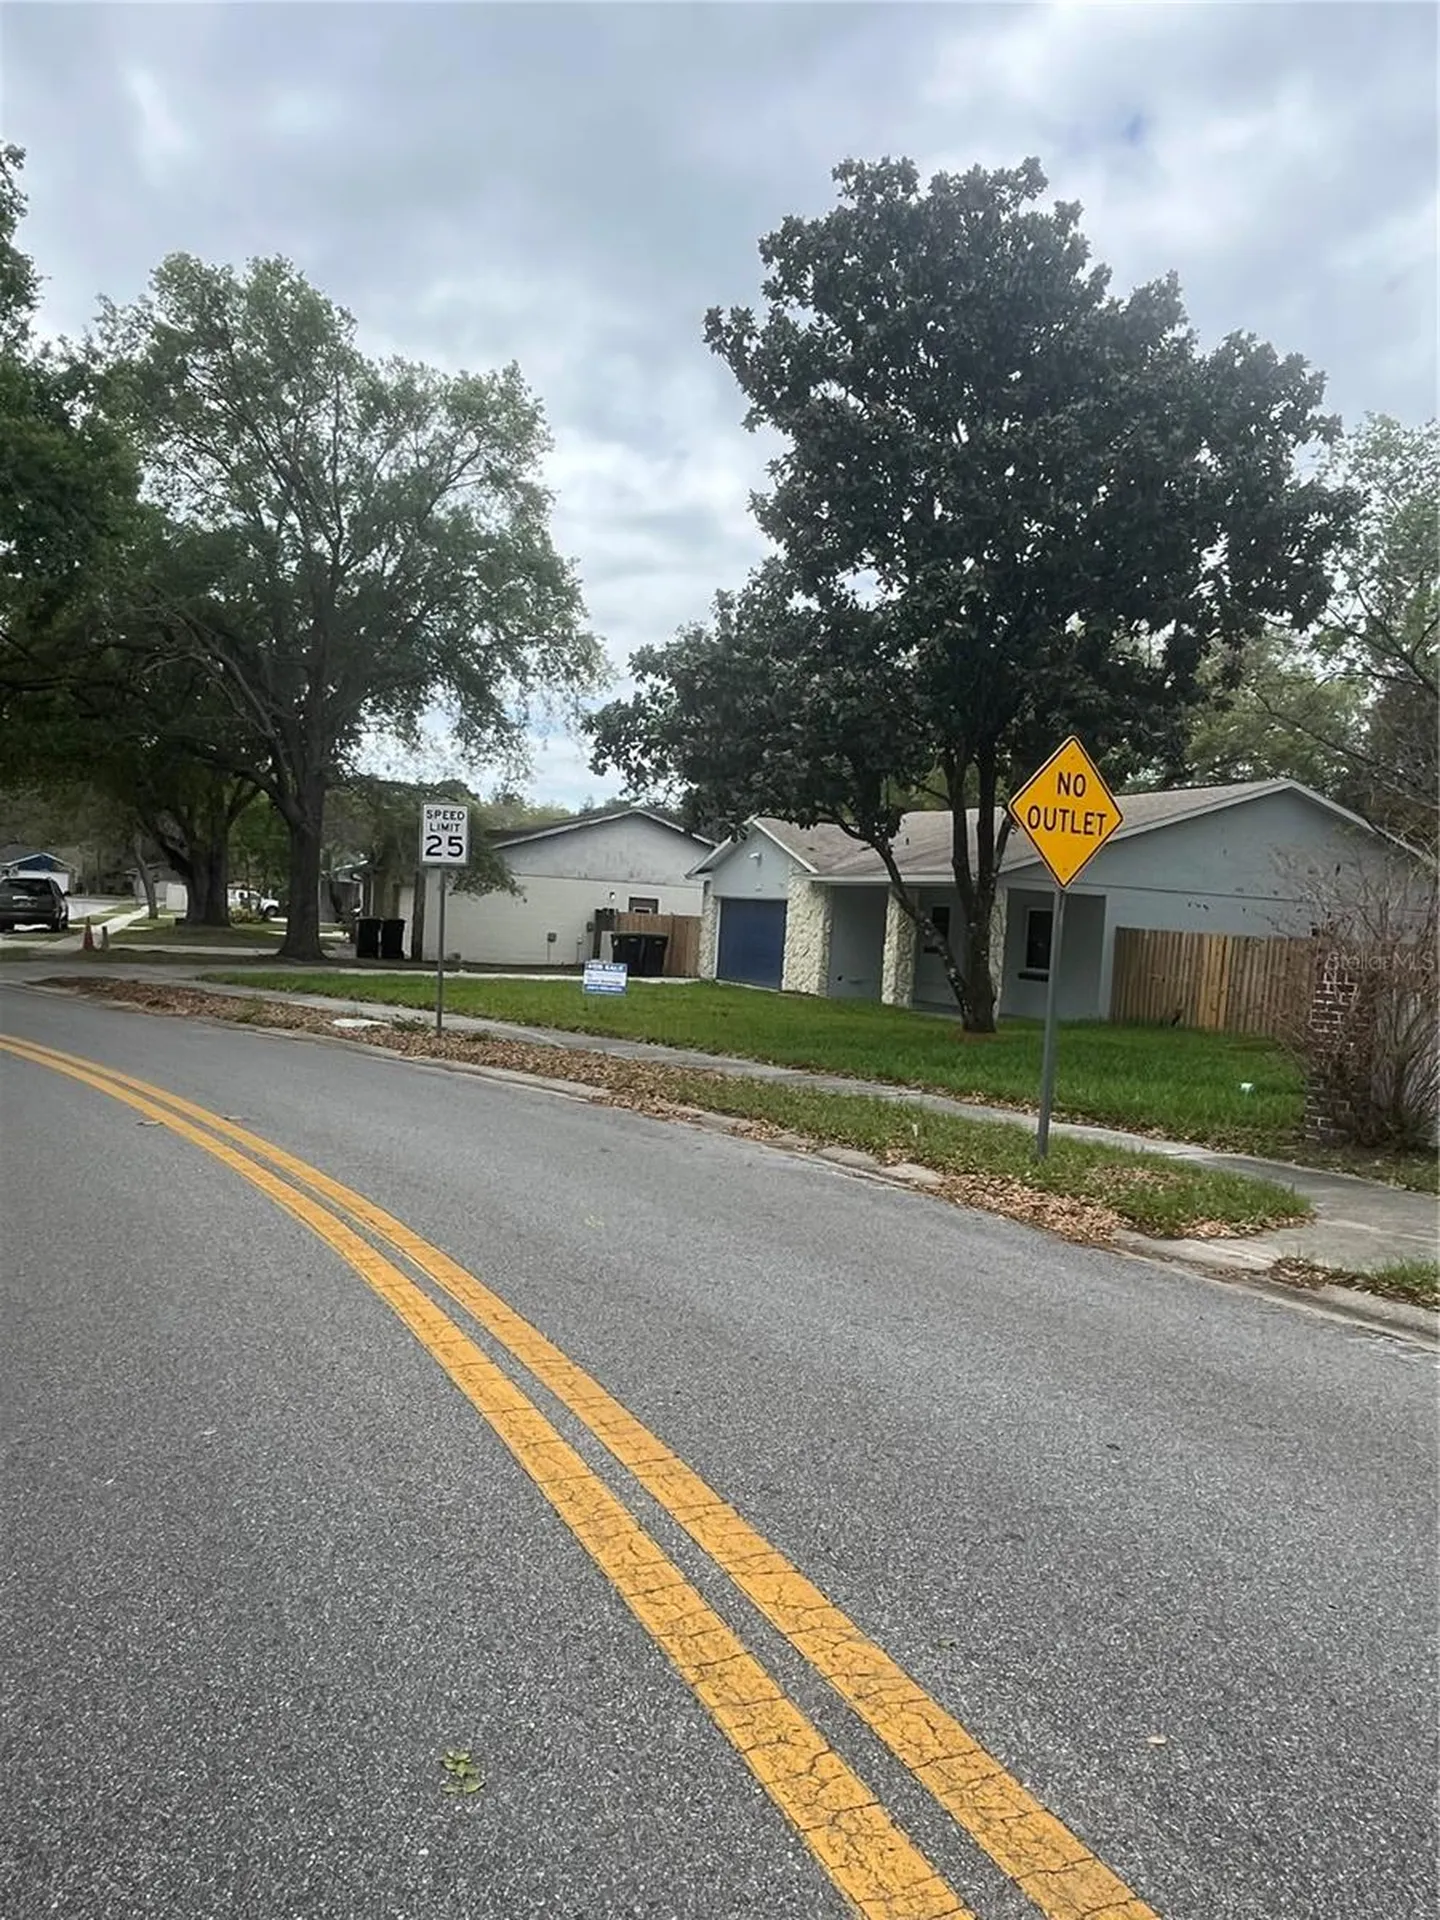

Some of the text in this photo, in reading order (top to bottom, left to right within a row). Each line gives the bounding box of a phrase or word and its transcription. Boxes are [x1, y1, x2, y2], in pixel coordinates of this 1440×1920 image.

[1057, 771, 1087, 798] NO
[426, 809, 465, 820] SPEED
[1027, 804, 1107, 837] OUTLET
[429, 822, 461, 832] LIMIT
[425, 834, 464, 858] 25
